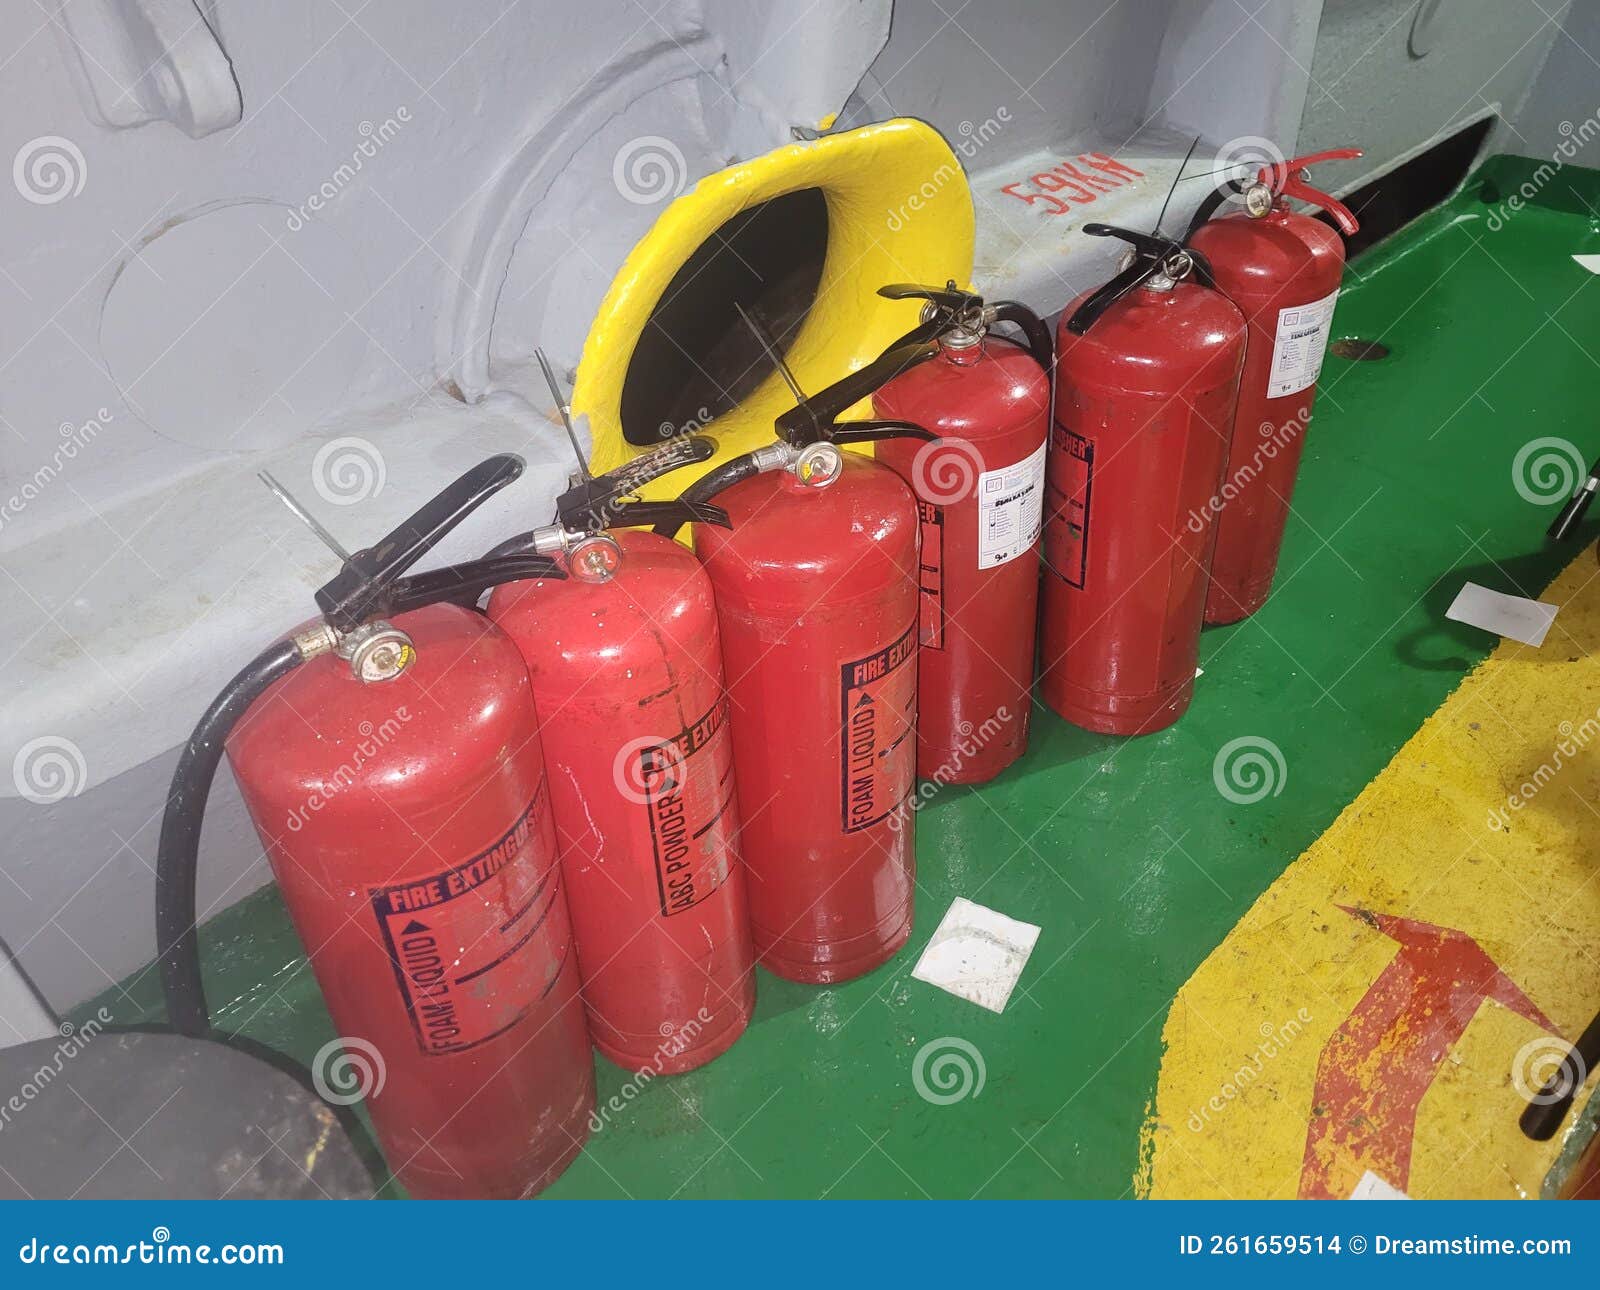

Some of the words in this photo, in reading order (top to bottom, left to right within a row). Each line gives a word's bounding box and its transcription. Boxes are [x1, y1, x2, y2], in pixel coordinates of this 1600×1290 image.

[1000, 152, 1145, 215] 59KN
[854, 654, 886, 685] FIRE
[652, 735, 692, 771] FIRE
[852, 709, 875, 773] LIQUID
[852, 774, 875, 826] FOAM
[388, 880, 443, 913] FIRE
[446, 811, 537, 896] EXTINGUIS
[658, 795, 690, 874] POWDER
[667, 873, 694, 911] ABC
[402, 935, 449, 998] LIQUID
[420, 1000, 465, 1050] FOAM
